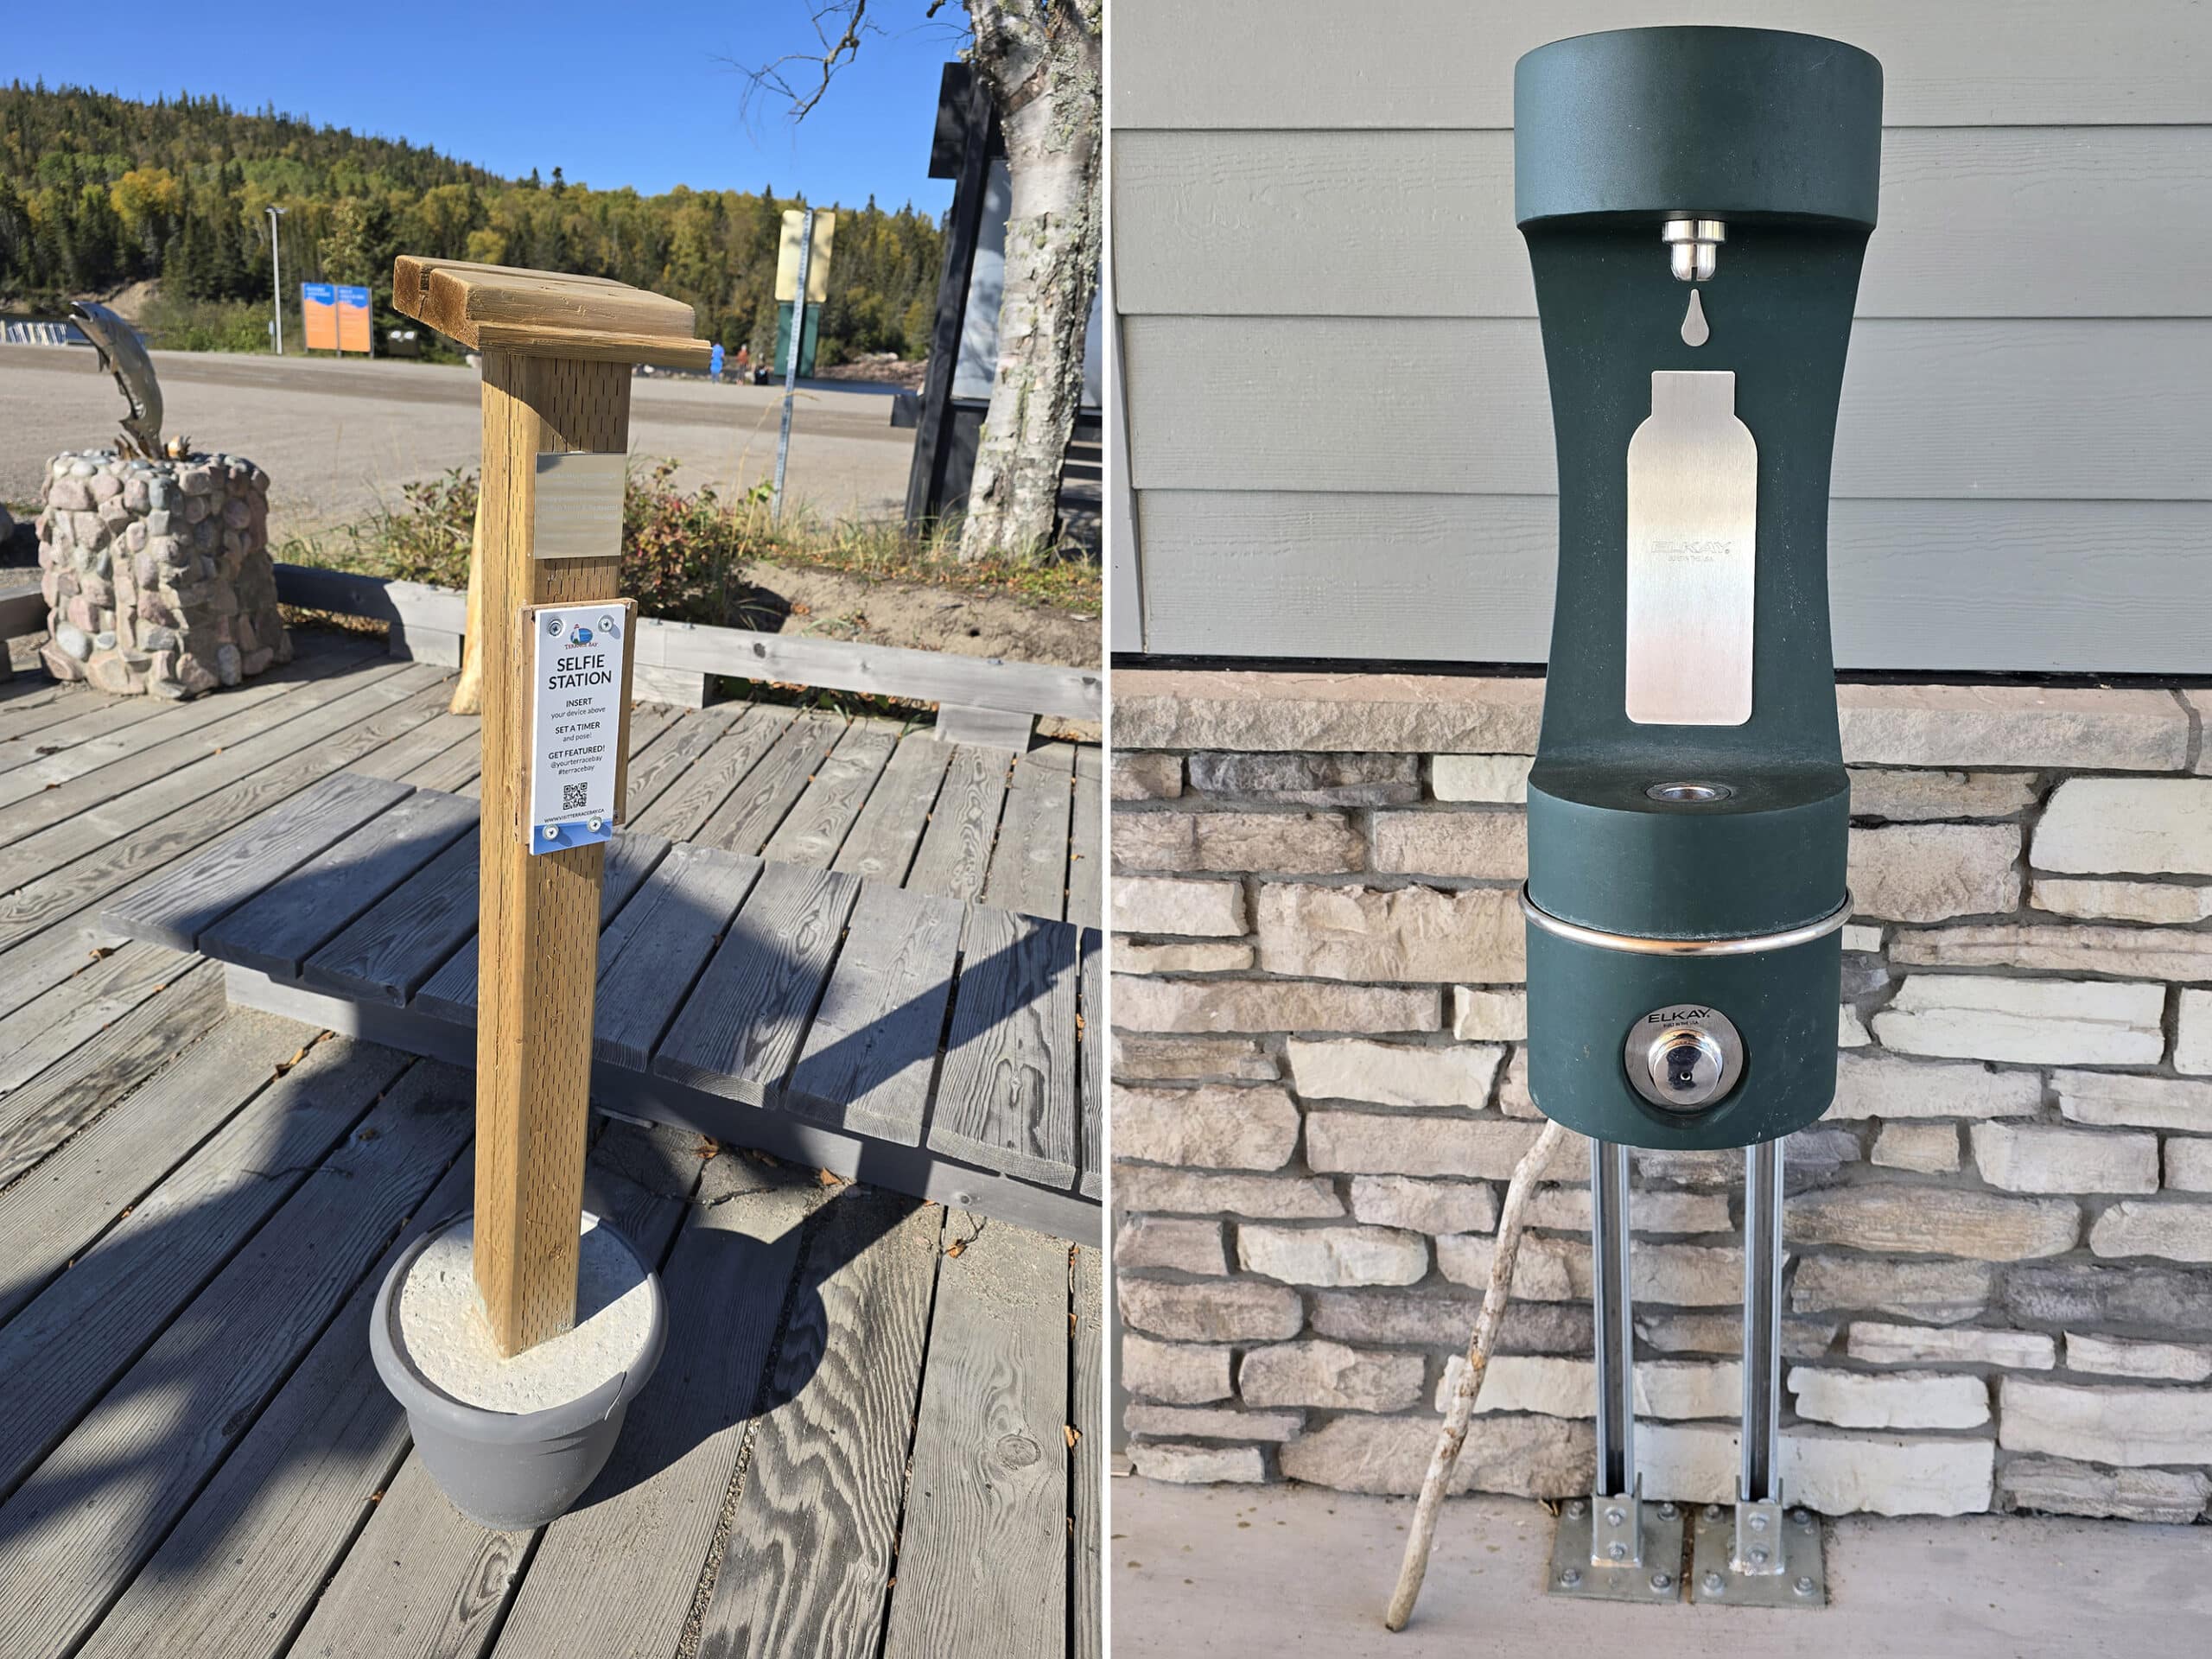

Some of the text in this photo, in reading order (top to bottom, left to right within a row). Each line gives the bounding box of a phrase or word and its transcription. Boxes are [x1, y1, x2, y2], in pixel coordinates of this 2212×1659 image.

[556, 654, 606, 672] SELFIE
[548, 670, 612, 690] STATION
[566, 697, 593, 708] INSERT
[550, 711, 566, 720] your
[566, 709, 587, 717] device
[555, 726, 569, 734] SET
[576, 721, 601, 731] TIMER
[575, 732, 593, 741] pose!
[548, 744, 606, 760] GET FEATURED!
[550, 755, 603, 769] @yourterracebay
[558, 765, 595, 775] #terracebay
[1648, 1008, 1711, 1023] ELKAY
